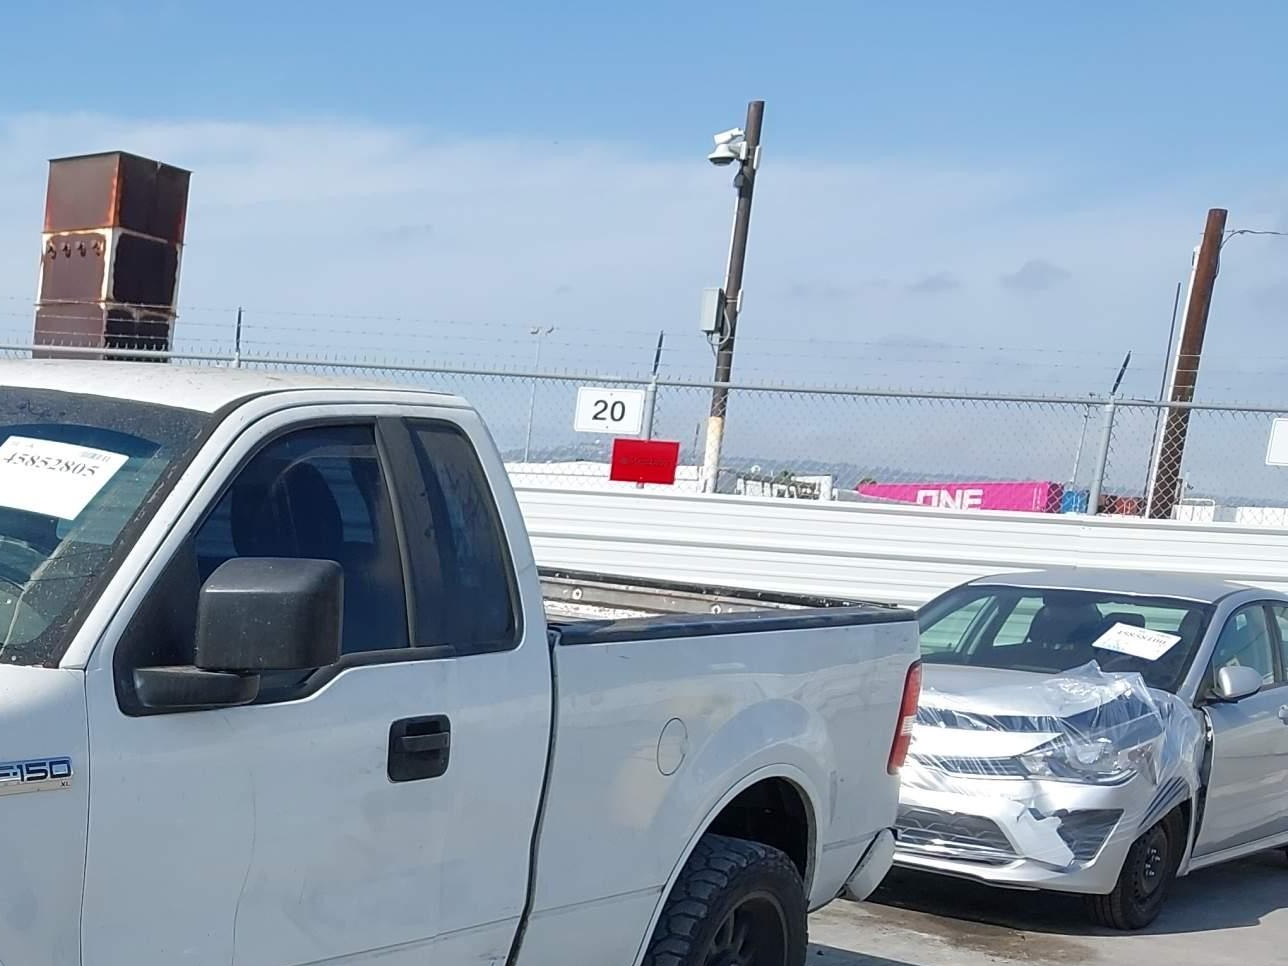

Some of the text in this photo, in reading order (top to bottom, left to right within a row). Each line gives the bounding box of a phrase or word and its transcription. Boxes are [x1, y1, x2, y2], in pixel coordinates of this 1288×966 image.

[592, 399, 626, 422] 20
[3, 452, 100, 477] 45852805
[916, 489, 984, 510] ONE
